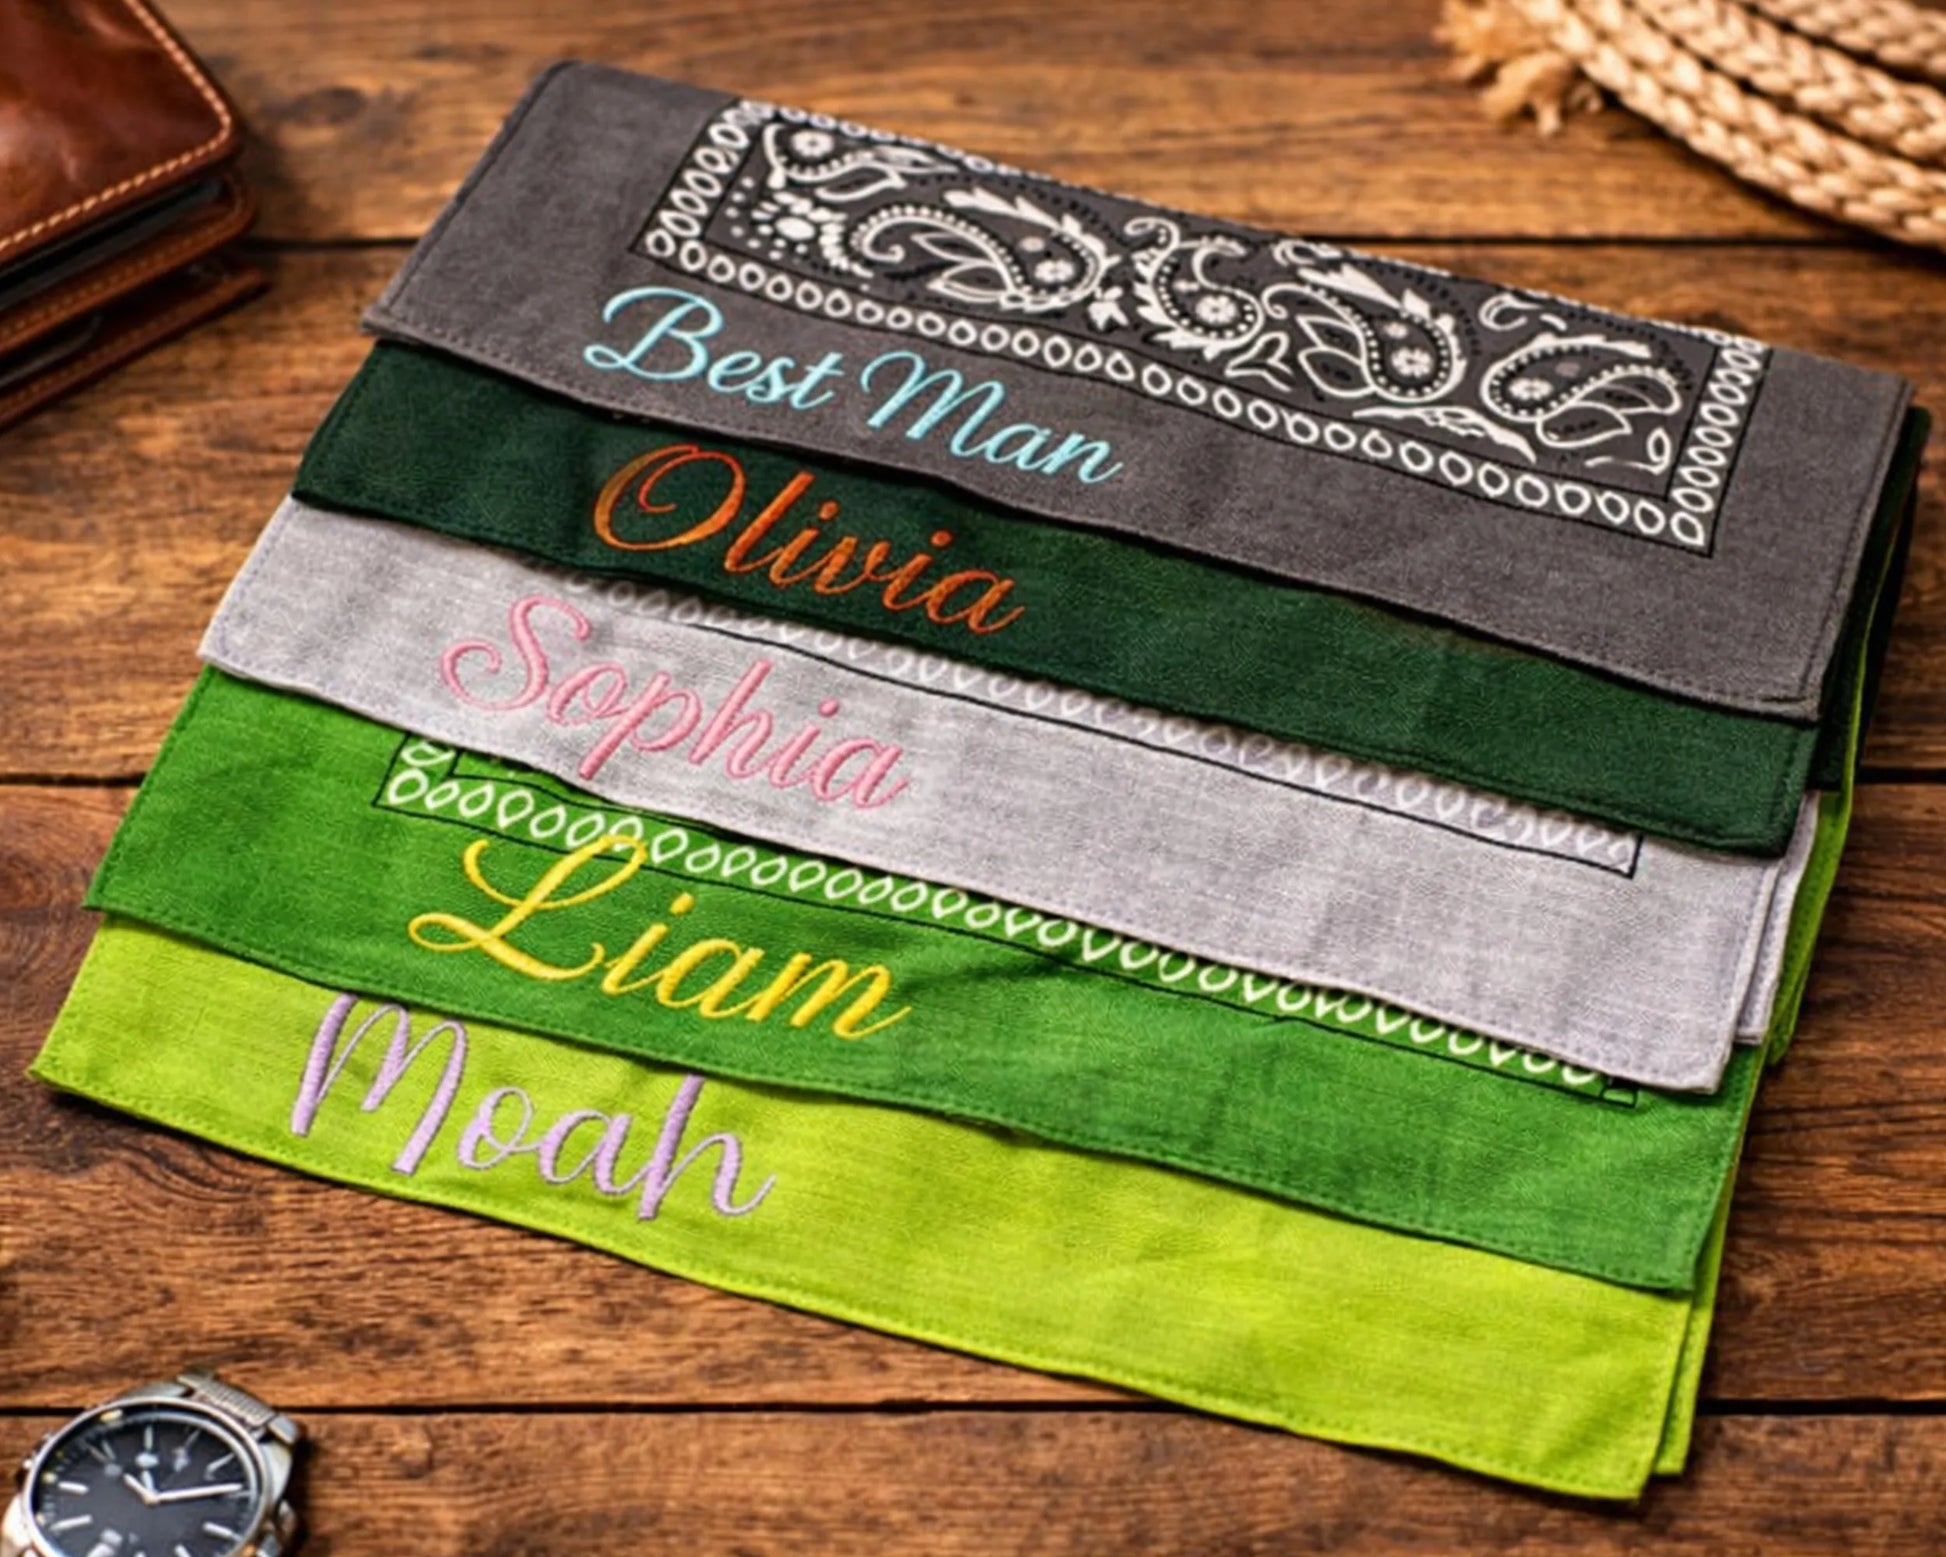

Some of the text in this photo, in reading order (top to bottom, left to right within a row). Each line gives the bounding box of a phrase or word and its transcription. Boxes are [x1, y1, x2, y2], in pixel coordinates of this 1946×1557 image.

[583, 286, 1125, 484] Best Man
[593, 444, 1026, 635] Olivia
[440, 594, 911, 808] Sophia
[408, 835, 912, 1041] Liam
